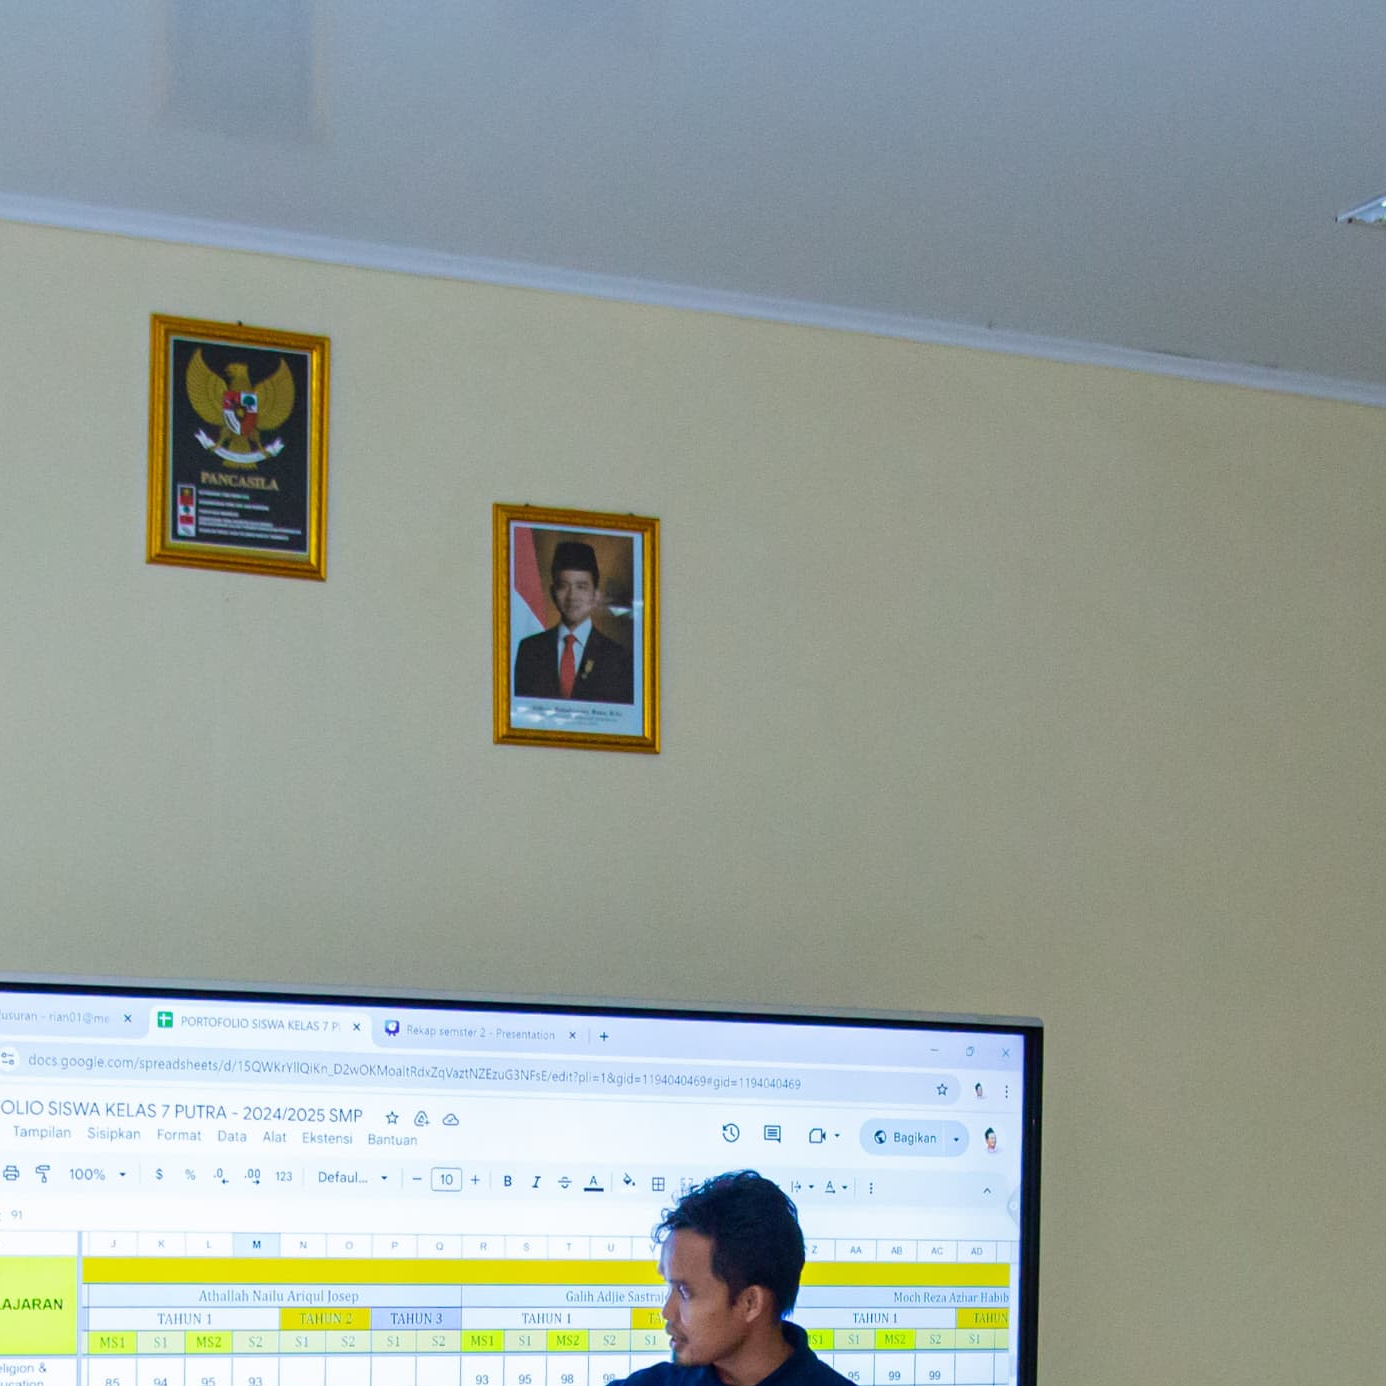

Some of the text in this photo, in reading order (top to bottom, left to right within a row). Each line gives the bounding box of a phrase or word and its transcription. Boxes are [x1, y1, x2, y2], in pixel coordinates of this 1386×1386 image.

[200, 471, 279, 491] PANCASILA
[181, 1016, 329, 1031] PORTOFOLIO SISWA KELAS 7
[406, 1024, 436, 1037] Rekap
[496, 1028, 555, 1041] Presentation
[48, 1099, 102, 1117] SISWA
[106, 1101, 156, 1118] KELAS
[161, 1102, 171, 1118] 7
[175, 1103, 227, 1120] PUTRA
[243, 1105, 325, 1123] 2024/2025
[329, 1107, 363, 1123] SMP
[13, 1125, 71, 1142] Tampilan
[88, 1126, 141, 1144] Sisipkan
[157, 1128, 202, 1142] Format
[217, 1129, 247, 1143] Data
[263, 1130, 287, 1144] Alat
[302, 1131, 353, 1145] Ekstensi
[368, 1133, 417, 1147] Bantuan
[893, 1131, 937, 1147] Bagikan
[69, 1168, 106, 1182] 100%
[276, 1171, 292, 1182] 123
[318, 1171, 368, 1184] Defaul...
[440, 1173, 453, 1186] 10
[199, 1289, 359, 1305] Athallah Nailu Ariqul Josep
[566, 1291, 594, 1302] Galih
[597, 1291, 625, 1304] Adjie
[894, 1292, 921, 1303] Moch
[923, 1292, 946, 1303] Reza
[948, 1292, 978, 1303] Azhar
[157, 1313, 202, 1325] TAHUN
[300, 1313, 352, 1325] TAHUN 2
[390, 1313, 443, 1325] TAHUN 3
[522, 1313, 562, 1325] TAHUN
[853, 1312, 890, 1324] TAHUN
[974, 1312, 1008, 1324] TAHUN
[100, 1336, 125, 1348] MS1
[154, 1336, 167, 1348] S1
[196, 1335, 221, 1348] MS2
[248, 1335, 263, 1348] S2
[295, 1335, 308, 1348] S1
[341, 1335, 355, 1347] S2
[387, 1335, 400, 1347] S1
[432, 1335, 446, 1347] S2
[471, 1336, 494, 1346] MS1
[519, 1336, 531, 1346] S1
[556, 1335, 579, 1346] MS2
[603, 1335, 616, 1346] S2
[645, 1335, 657, 1346] S1
[848, 1334, 860, 1345] S1
[885, 1334, 906, 1345] MS2
[929, 1334, 941, 1344] S2
[969, 1334, 980, 1344] S1
[39, 1362, 47, 1373] &
[929, 1371, 941, 1380] 99
